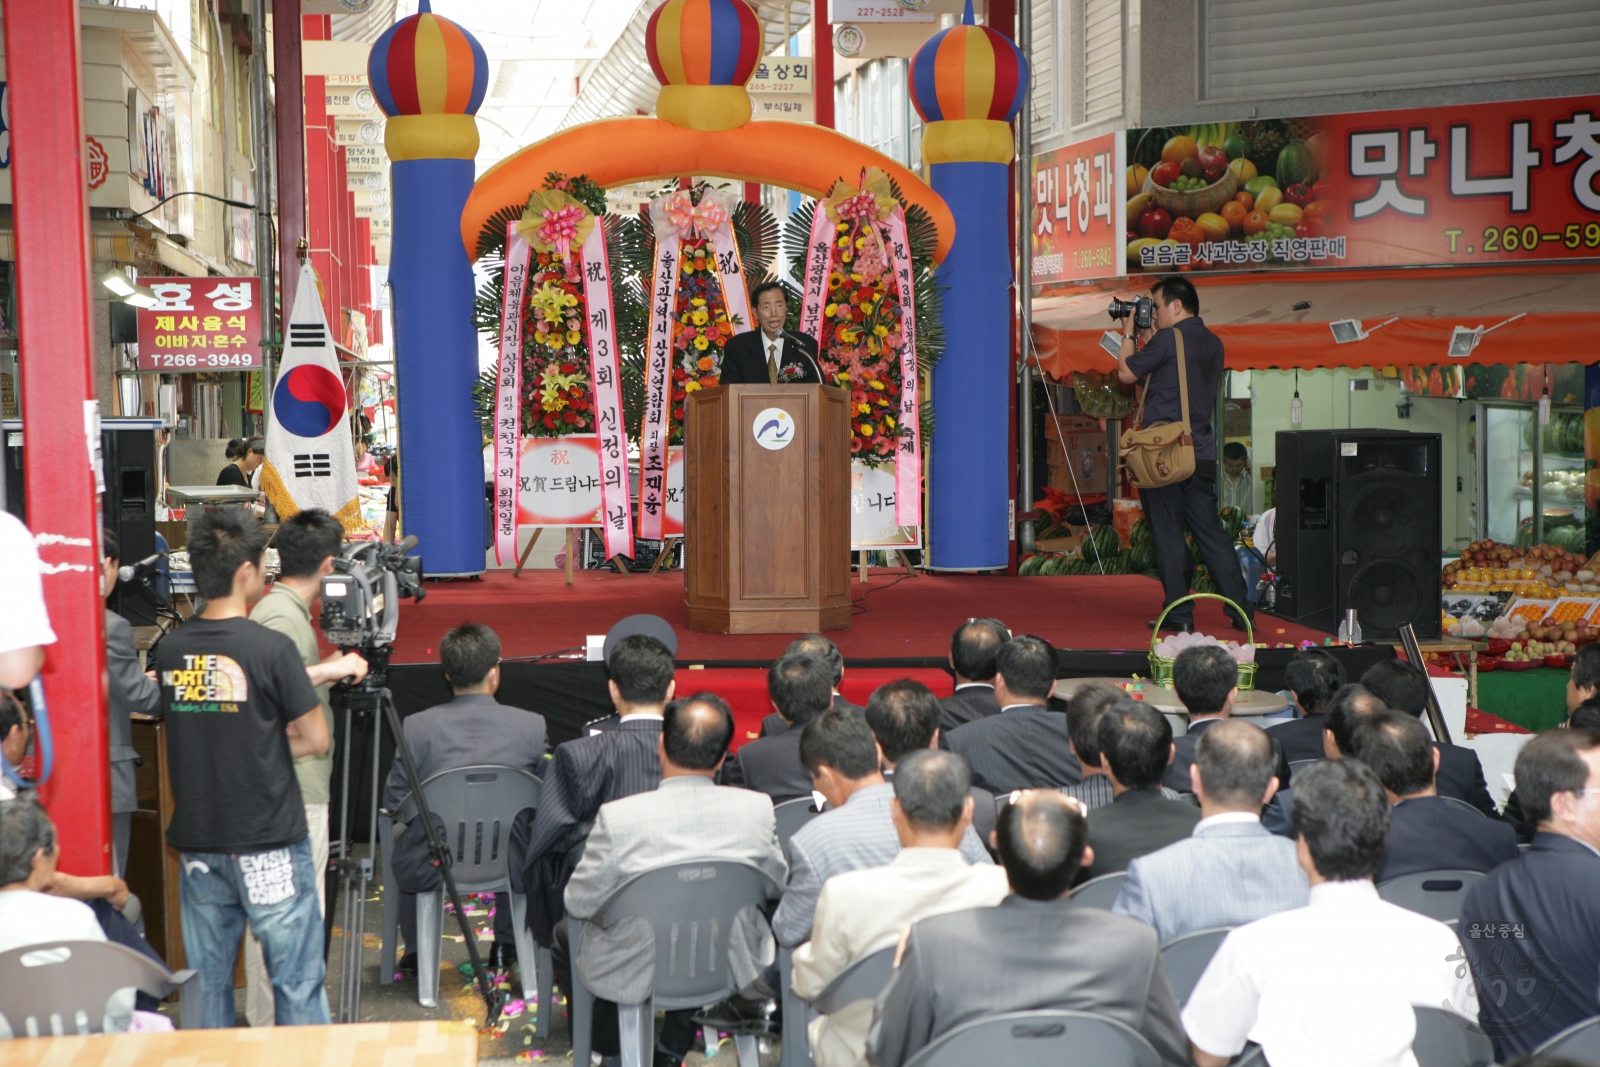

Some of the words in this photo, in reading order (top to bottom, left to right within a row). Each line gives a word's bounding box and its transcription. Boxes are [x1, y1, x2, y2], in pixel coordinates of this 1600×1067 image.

[857, 8, 904, 17] 227-2528
[750, 83, 794, 91] 265-2227
[763, 102, 802, 112] 부식일체
[1036, 151, 1113, 236] 맛나청과
[894, 241, 909, 260] 祝
[1140, 245, 1191, 267] 얼음골
[1196, 240, 1267, 264] 사과농장
[1271, 236, 1347, 261] 직영판매
[586, 261, 606, 283] 祝
[719, 250, 740, 275] 祝
[807, 241, 831, 297] 울산광역시
[147, 282, 253, 312] 효성
[655, 250, 675, 335] 울산광역시
[154, 315, 247, 332] 제사음식
[500, 352, 519, 389] 상인회
[648, 339, 668, 425] 상인연합회
[503, 396, 515, 411] 회장
[900, 427, 916, 455] 축제
[550, 449, 570, 466] 祝
[498, 467, 513, 480] 외
[498, 487, 514, 536] 회원일동
[183, 654, 217, 671] THE
[162, 670, 217, 686] NORTH
[174, 686, 217, 701] FACE
